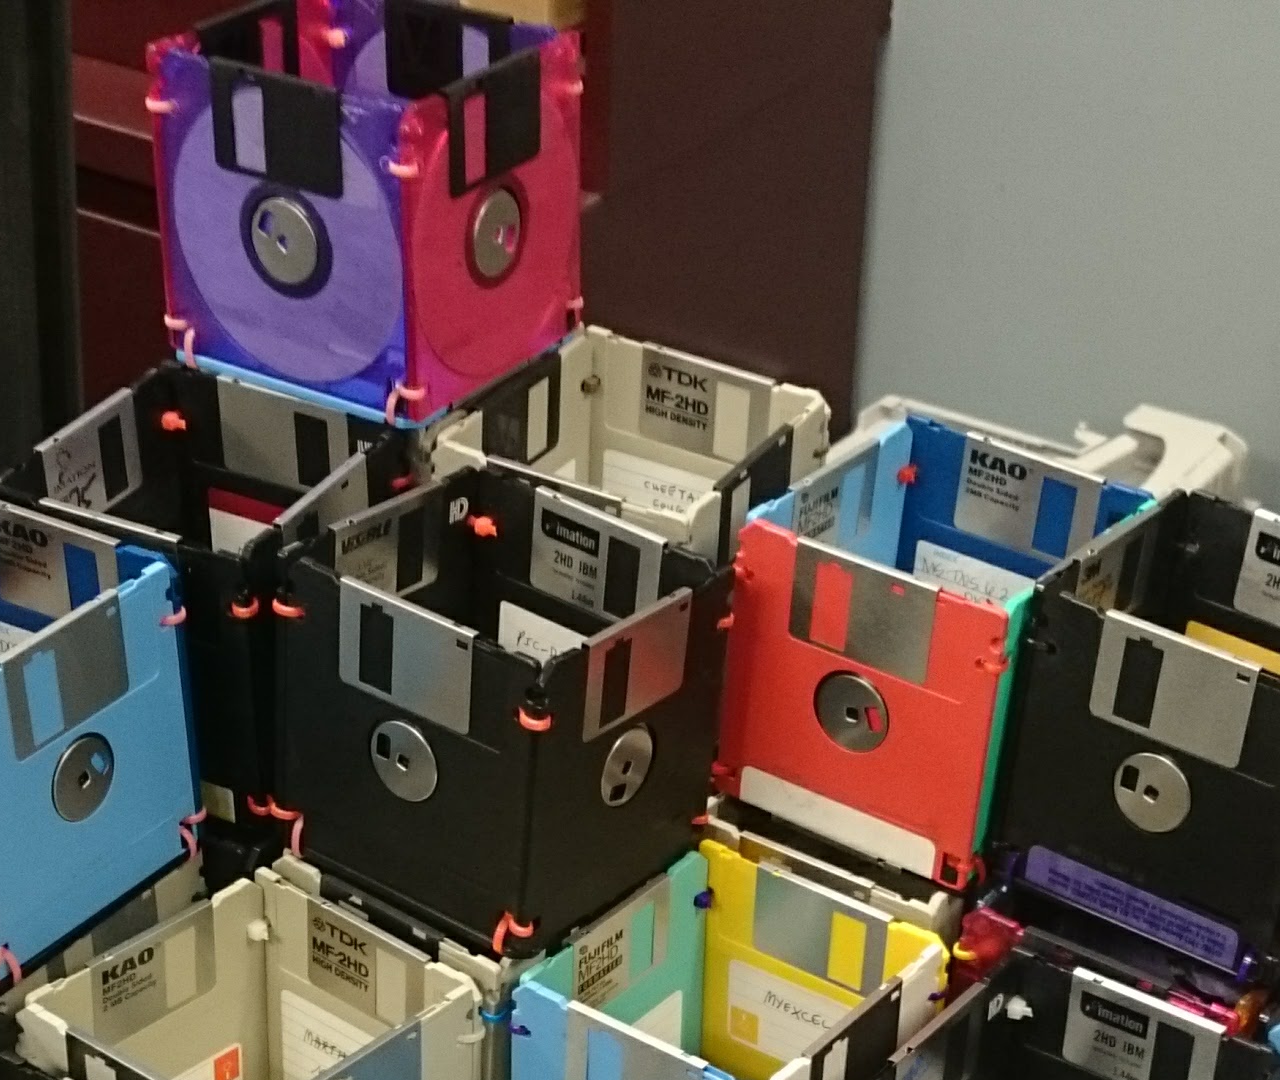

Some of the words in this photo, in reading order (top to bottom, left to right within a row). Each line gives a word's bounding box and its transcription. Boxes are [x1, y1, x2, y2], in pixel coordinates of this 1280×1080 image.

[662, 365, 708, 393] TDK
[646, 384, 709, 416] MF-2HD
[645, 404, 668, 419] HIGH
[669, 412, 708, 430] DENSITY
[967, 467, 1008, 487] MF2HD
[970, 448, 1028, 482] KAO
[644, 480, 698, 503] CHEETA
[449, 497, 469, 525] HD
[556, 521, 596, 550] imation
[554, 550, 574, 570] 2HD
[578, 561, 599, 580] IBM
[325, 921, 368, 957] TDK
[578, 929, 624, 969] FUJIFILM
[102, 946, 155, 986] KAO
[312, 936, 369, 978] MF-2HD
[578, 944, 619, 983] MF2HD
[102, 972, 136, 997] MF2HD
[312, 955, 333, 974] HIGH
[334, 966, 369, 993] DENSITY
[1097, 1002, 1144, 1034] imation
[1093, 1029, 1117, 1048] 2HD
[1122, 1038, 1145, 1060] IBM
